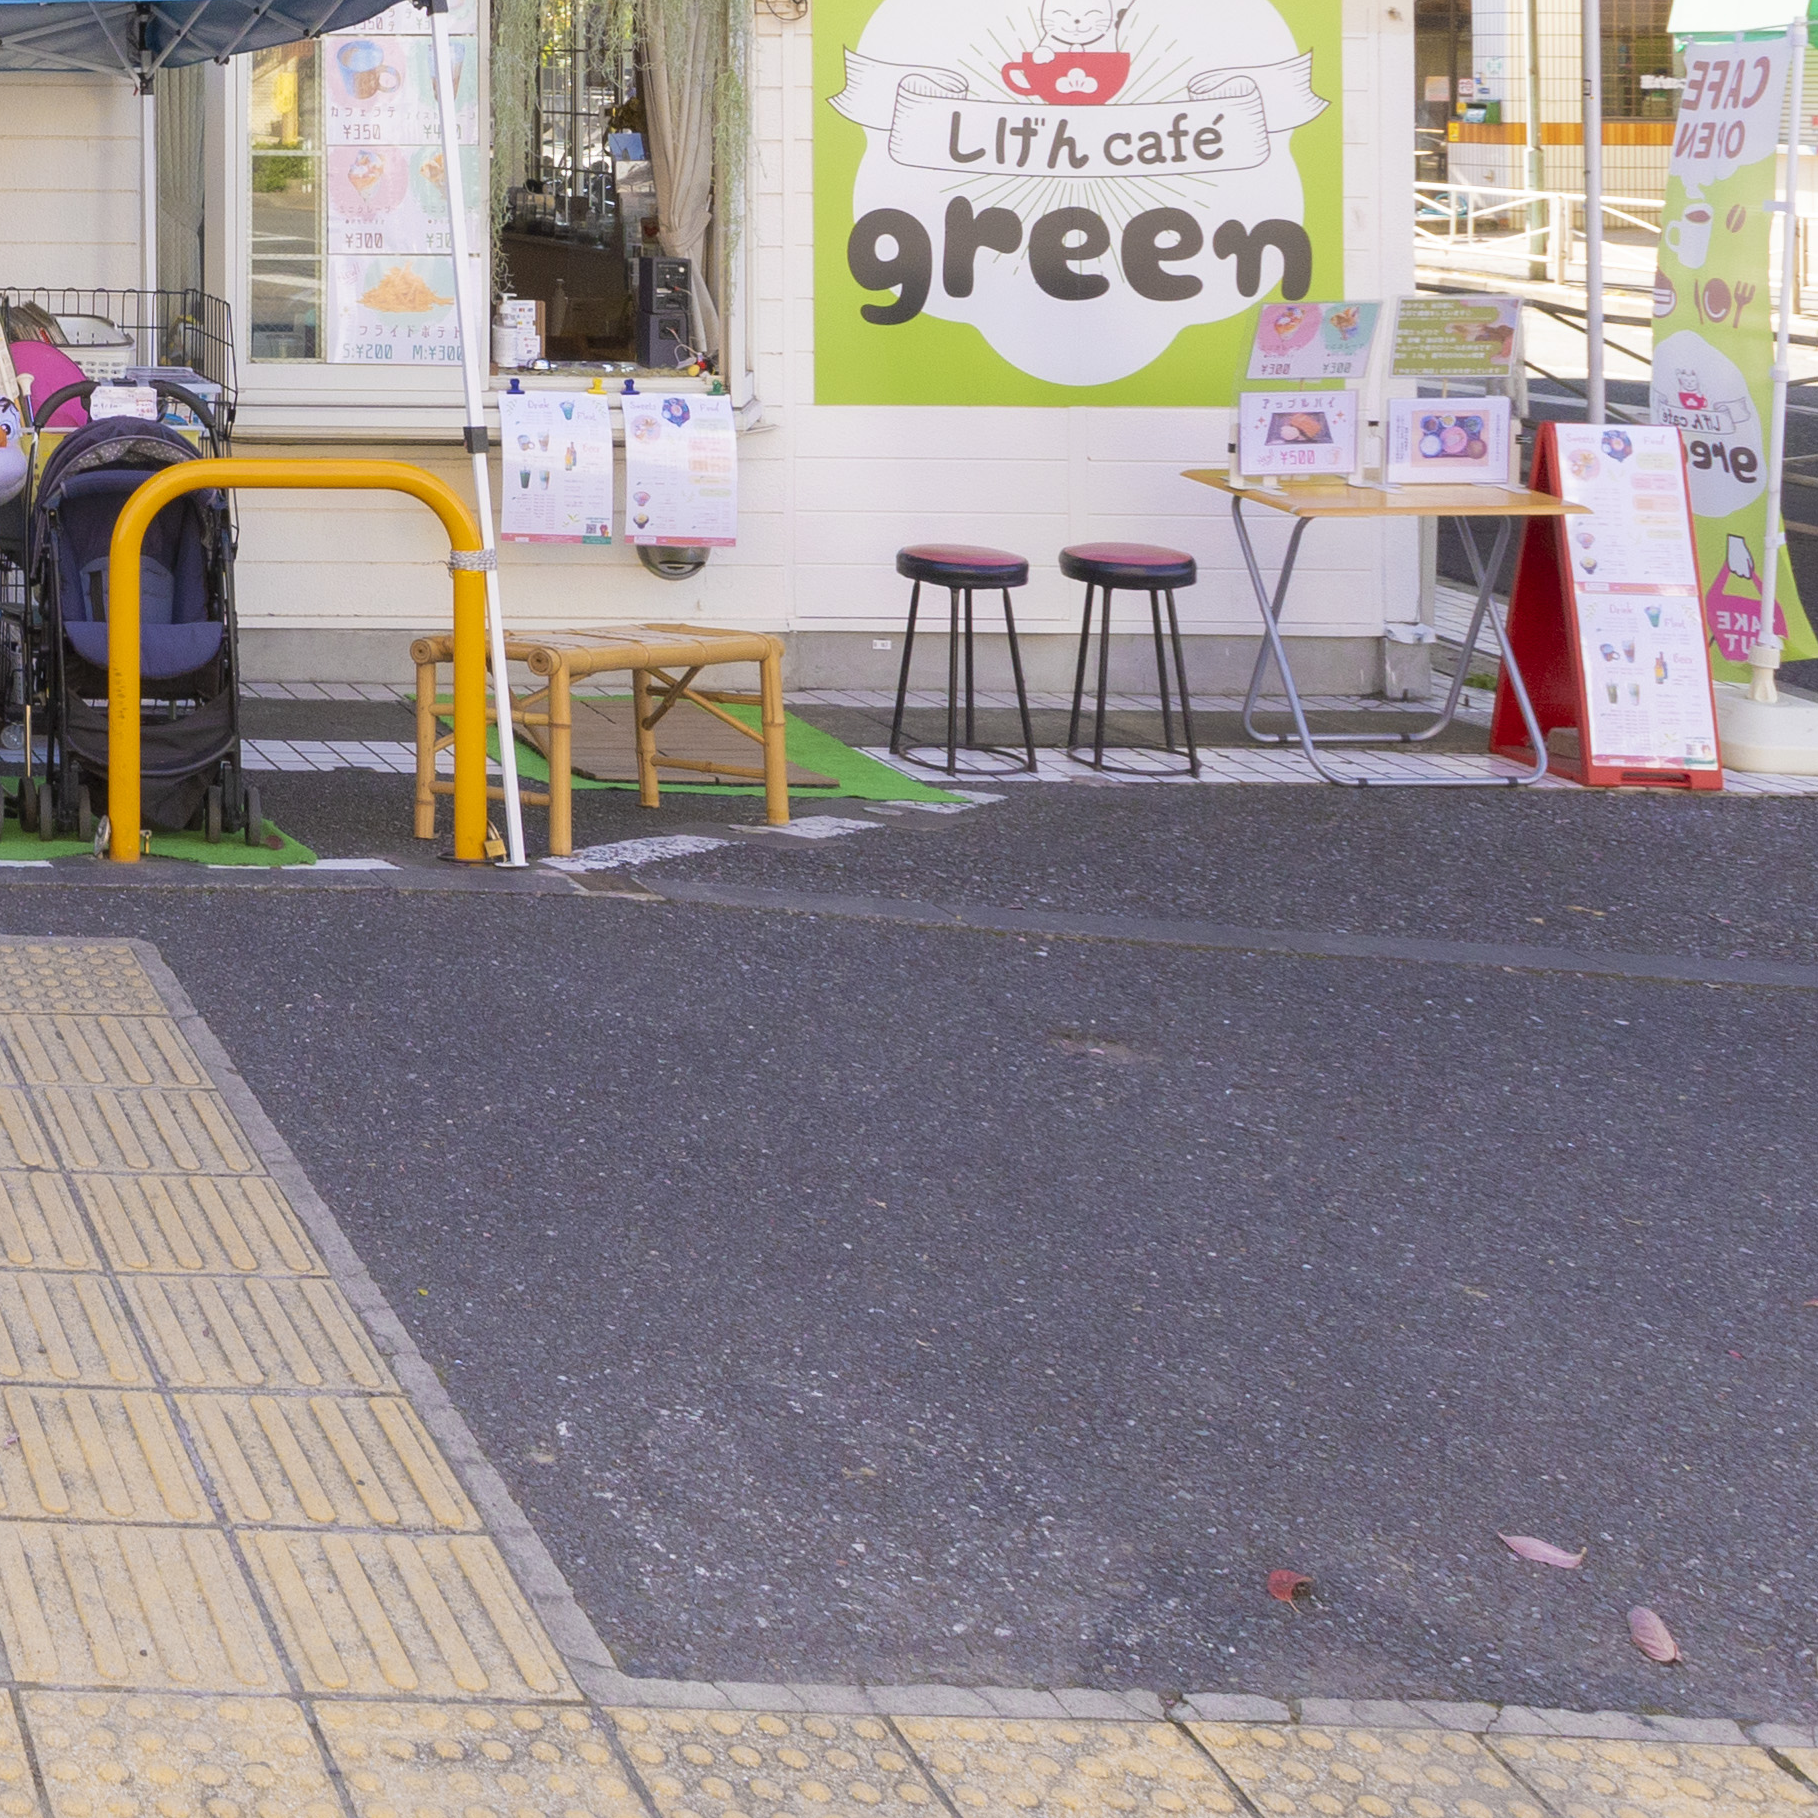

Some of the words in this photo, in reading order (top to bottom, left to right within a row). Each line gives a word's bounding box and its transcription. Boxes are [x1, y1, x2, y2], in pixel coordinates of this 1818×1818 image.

[330, 106, 396, 118] カフェラテ
[343, 124, 381, 140] ¥350
[423, 124, 462, 140] ¥40
[948, 111, 1090, 170] しげん
[1103, 113, 1227, 167] café
[345, 232, 383, 249] ¥300
[426, 232, 452, 249] ¥30
[847, 195, 1313, 326] green
[358, 324, 461, 339] フライドポテト
[343, 343, 393, 359] S:¥200
[1261, 363, 1291, 375] ¥300
[1322, 362, 1352, 374] ¥300
[1279, 449, 1316, 465] ¥500
